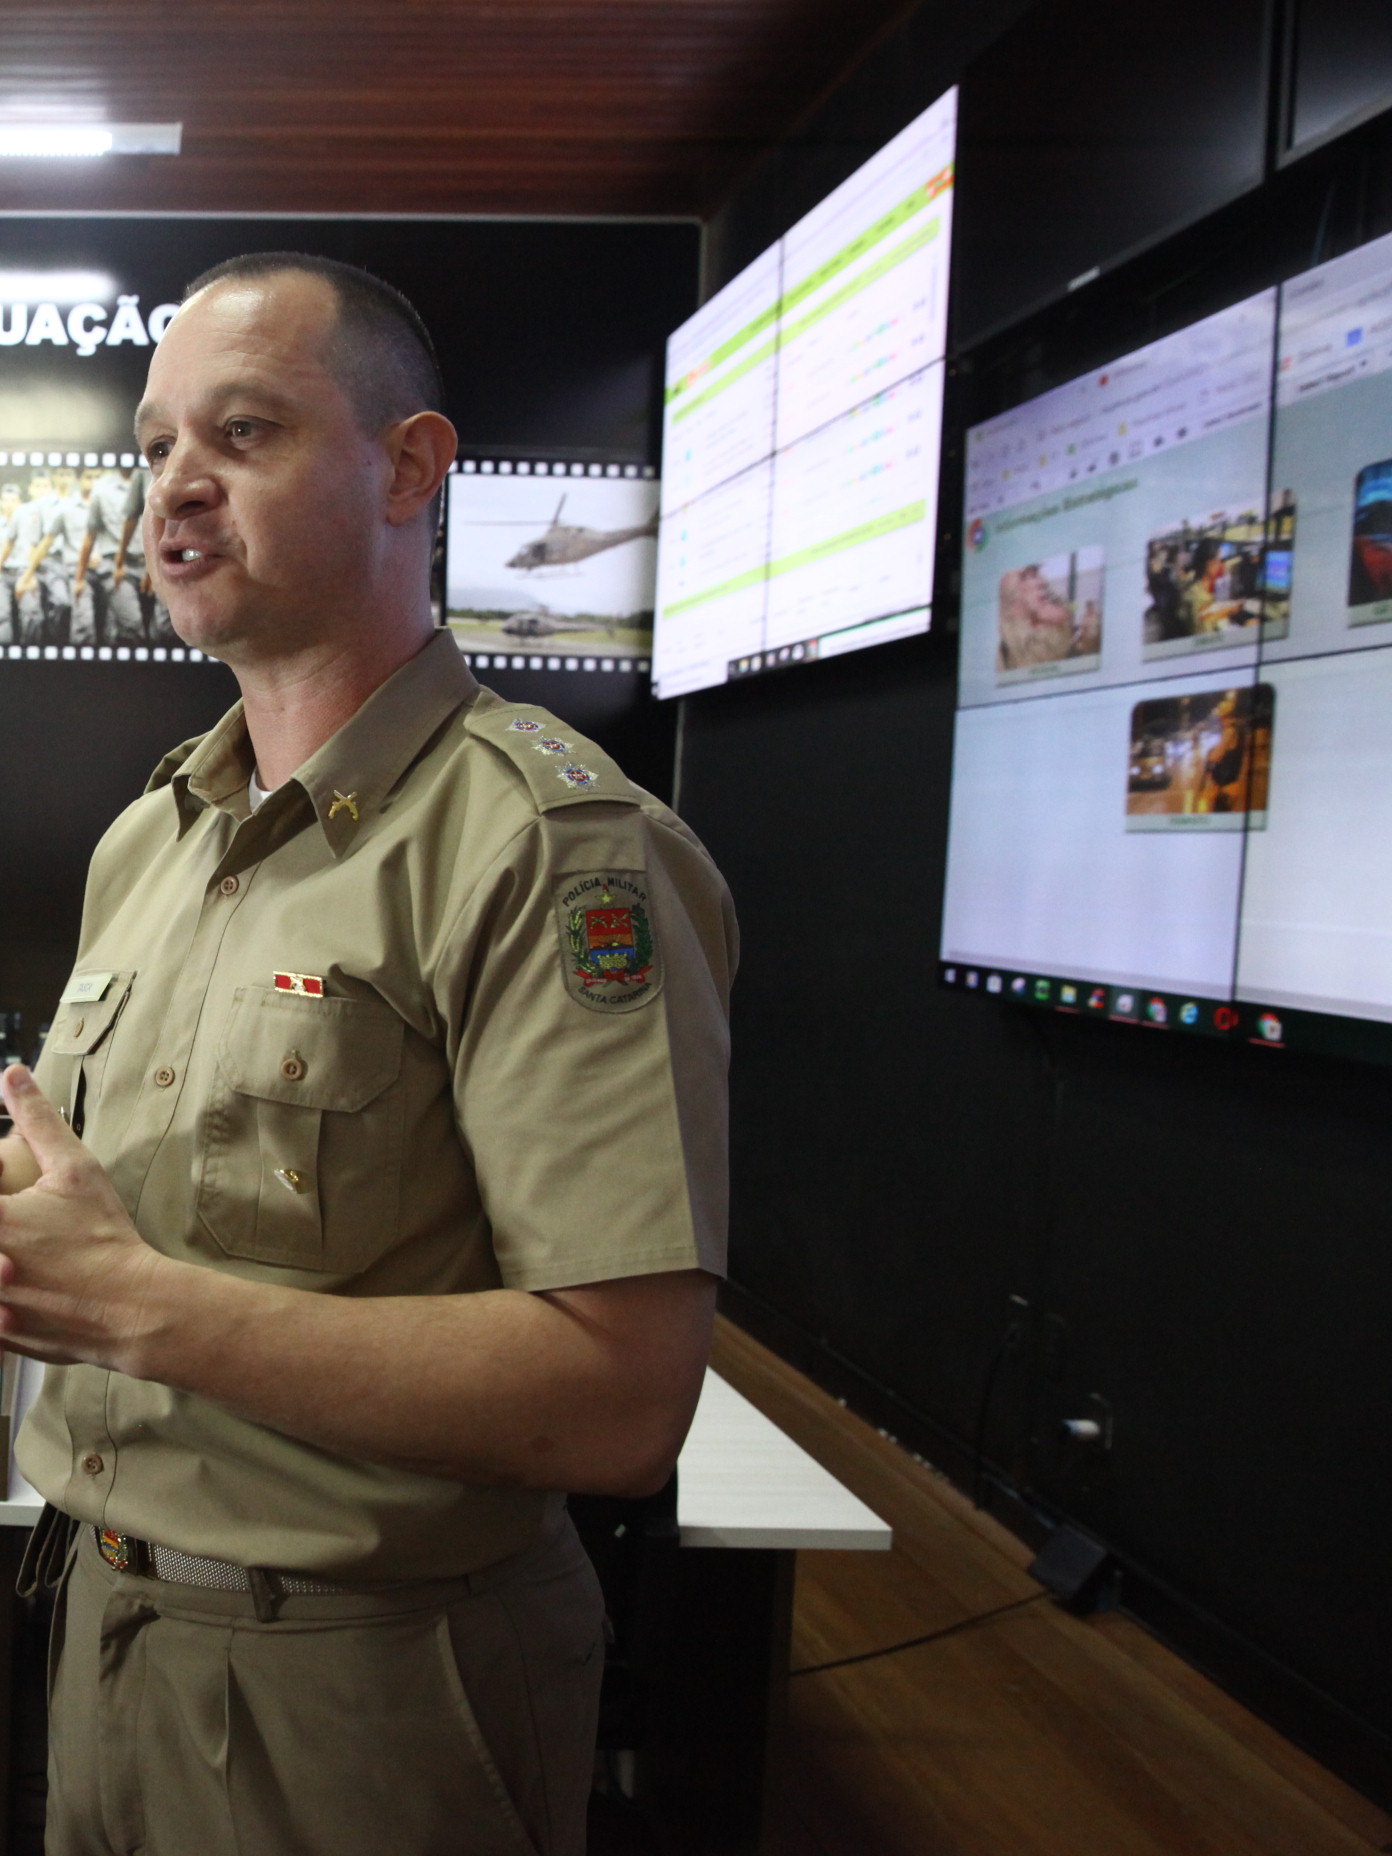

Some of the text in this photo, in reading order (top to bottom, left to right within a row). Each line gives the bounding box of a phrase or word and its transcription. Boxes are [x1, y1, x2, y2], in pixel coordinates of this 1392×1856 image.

[562, 877, 647, 907] POLÍCIA MILITAR
[578, 982, 652, 1005] SANTA CATARINA
